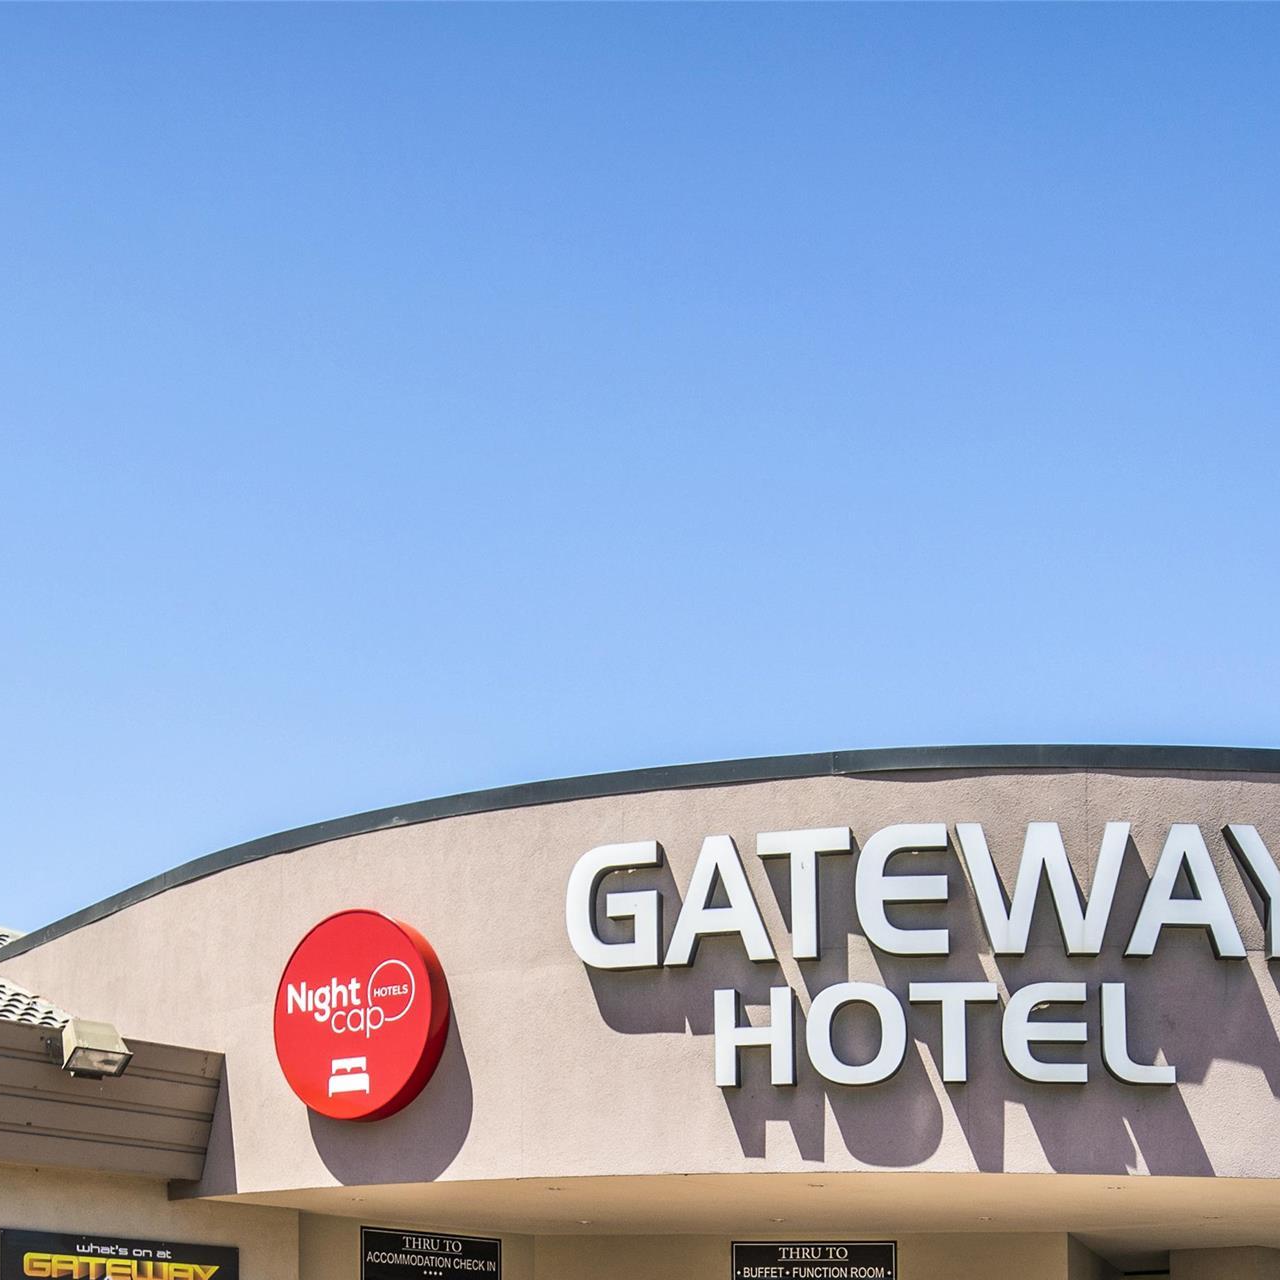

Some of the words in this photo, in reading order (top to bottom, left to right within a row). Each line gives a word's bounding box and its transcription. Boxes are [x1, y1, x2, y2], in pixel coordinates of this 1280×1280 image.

[286, 976, 361, 1023] Night
[373, 984, 409, 998] HOTELS
[331, 1005, 385, 1039] cap
[714, 981, 1177, 1088] HOTEL
[76, 1242, 129, 1256] what's
[133, 1248, 152, 1257] on
[157, 1249, 172, 1258] at
[402, 1235, 440, 1251] THRU
[443, 1239, 462, 1253] TO
[778, 1247, 821, 1259] THRU
[826, 1247, 848, 1259] TO
[366, 1251, 451, 1269] ACCOMMODATION
[453, 1258, 485, 1271] CHECK
[487, 1261, 496, 1272] IN
[743, 1267, 784, 1278] BUFFET
[792, 1267, 847, 1278] FUNCTION
[851, 1267, 884, 1278] ROOM
